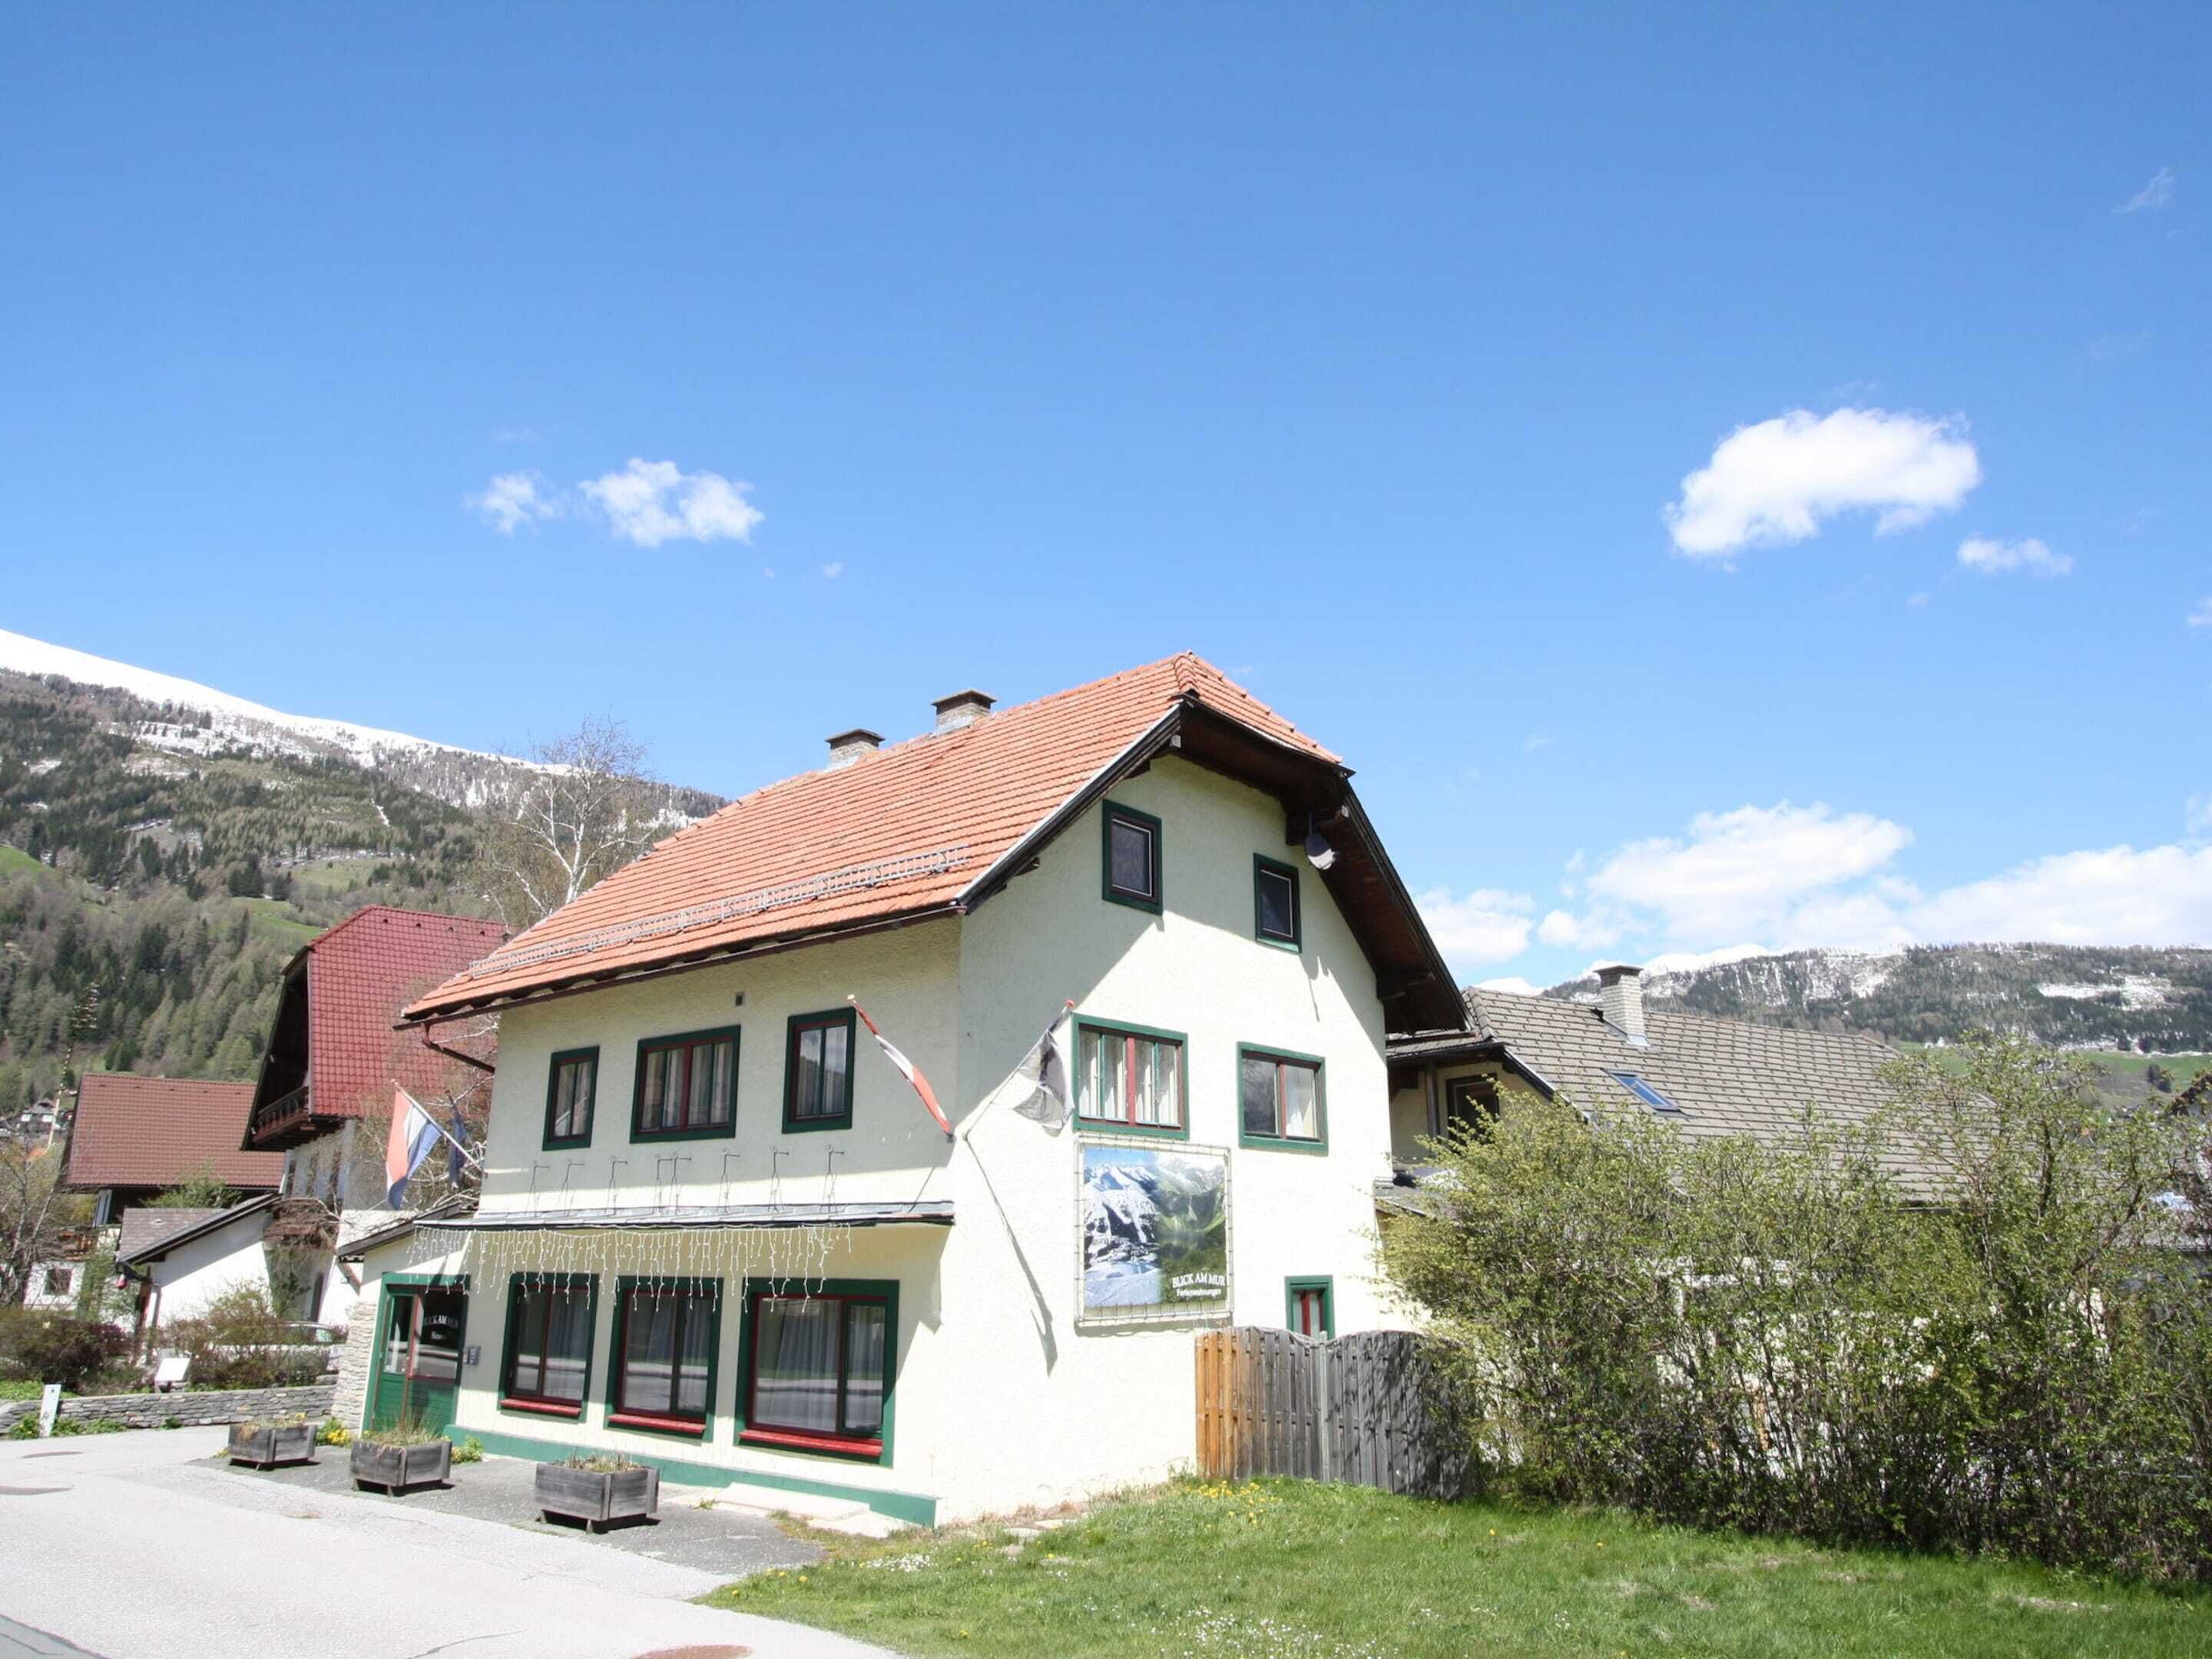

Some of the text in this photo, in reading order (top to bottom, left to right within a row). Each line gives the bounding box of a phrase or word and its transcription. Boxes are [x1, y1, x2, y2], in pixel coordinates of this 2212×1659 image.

[1172, 1272, 1226, 1288] BLICK AM MUR
